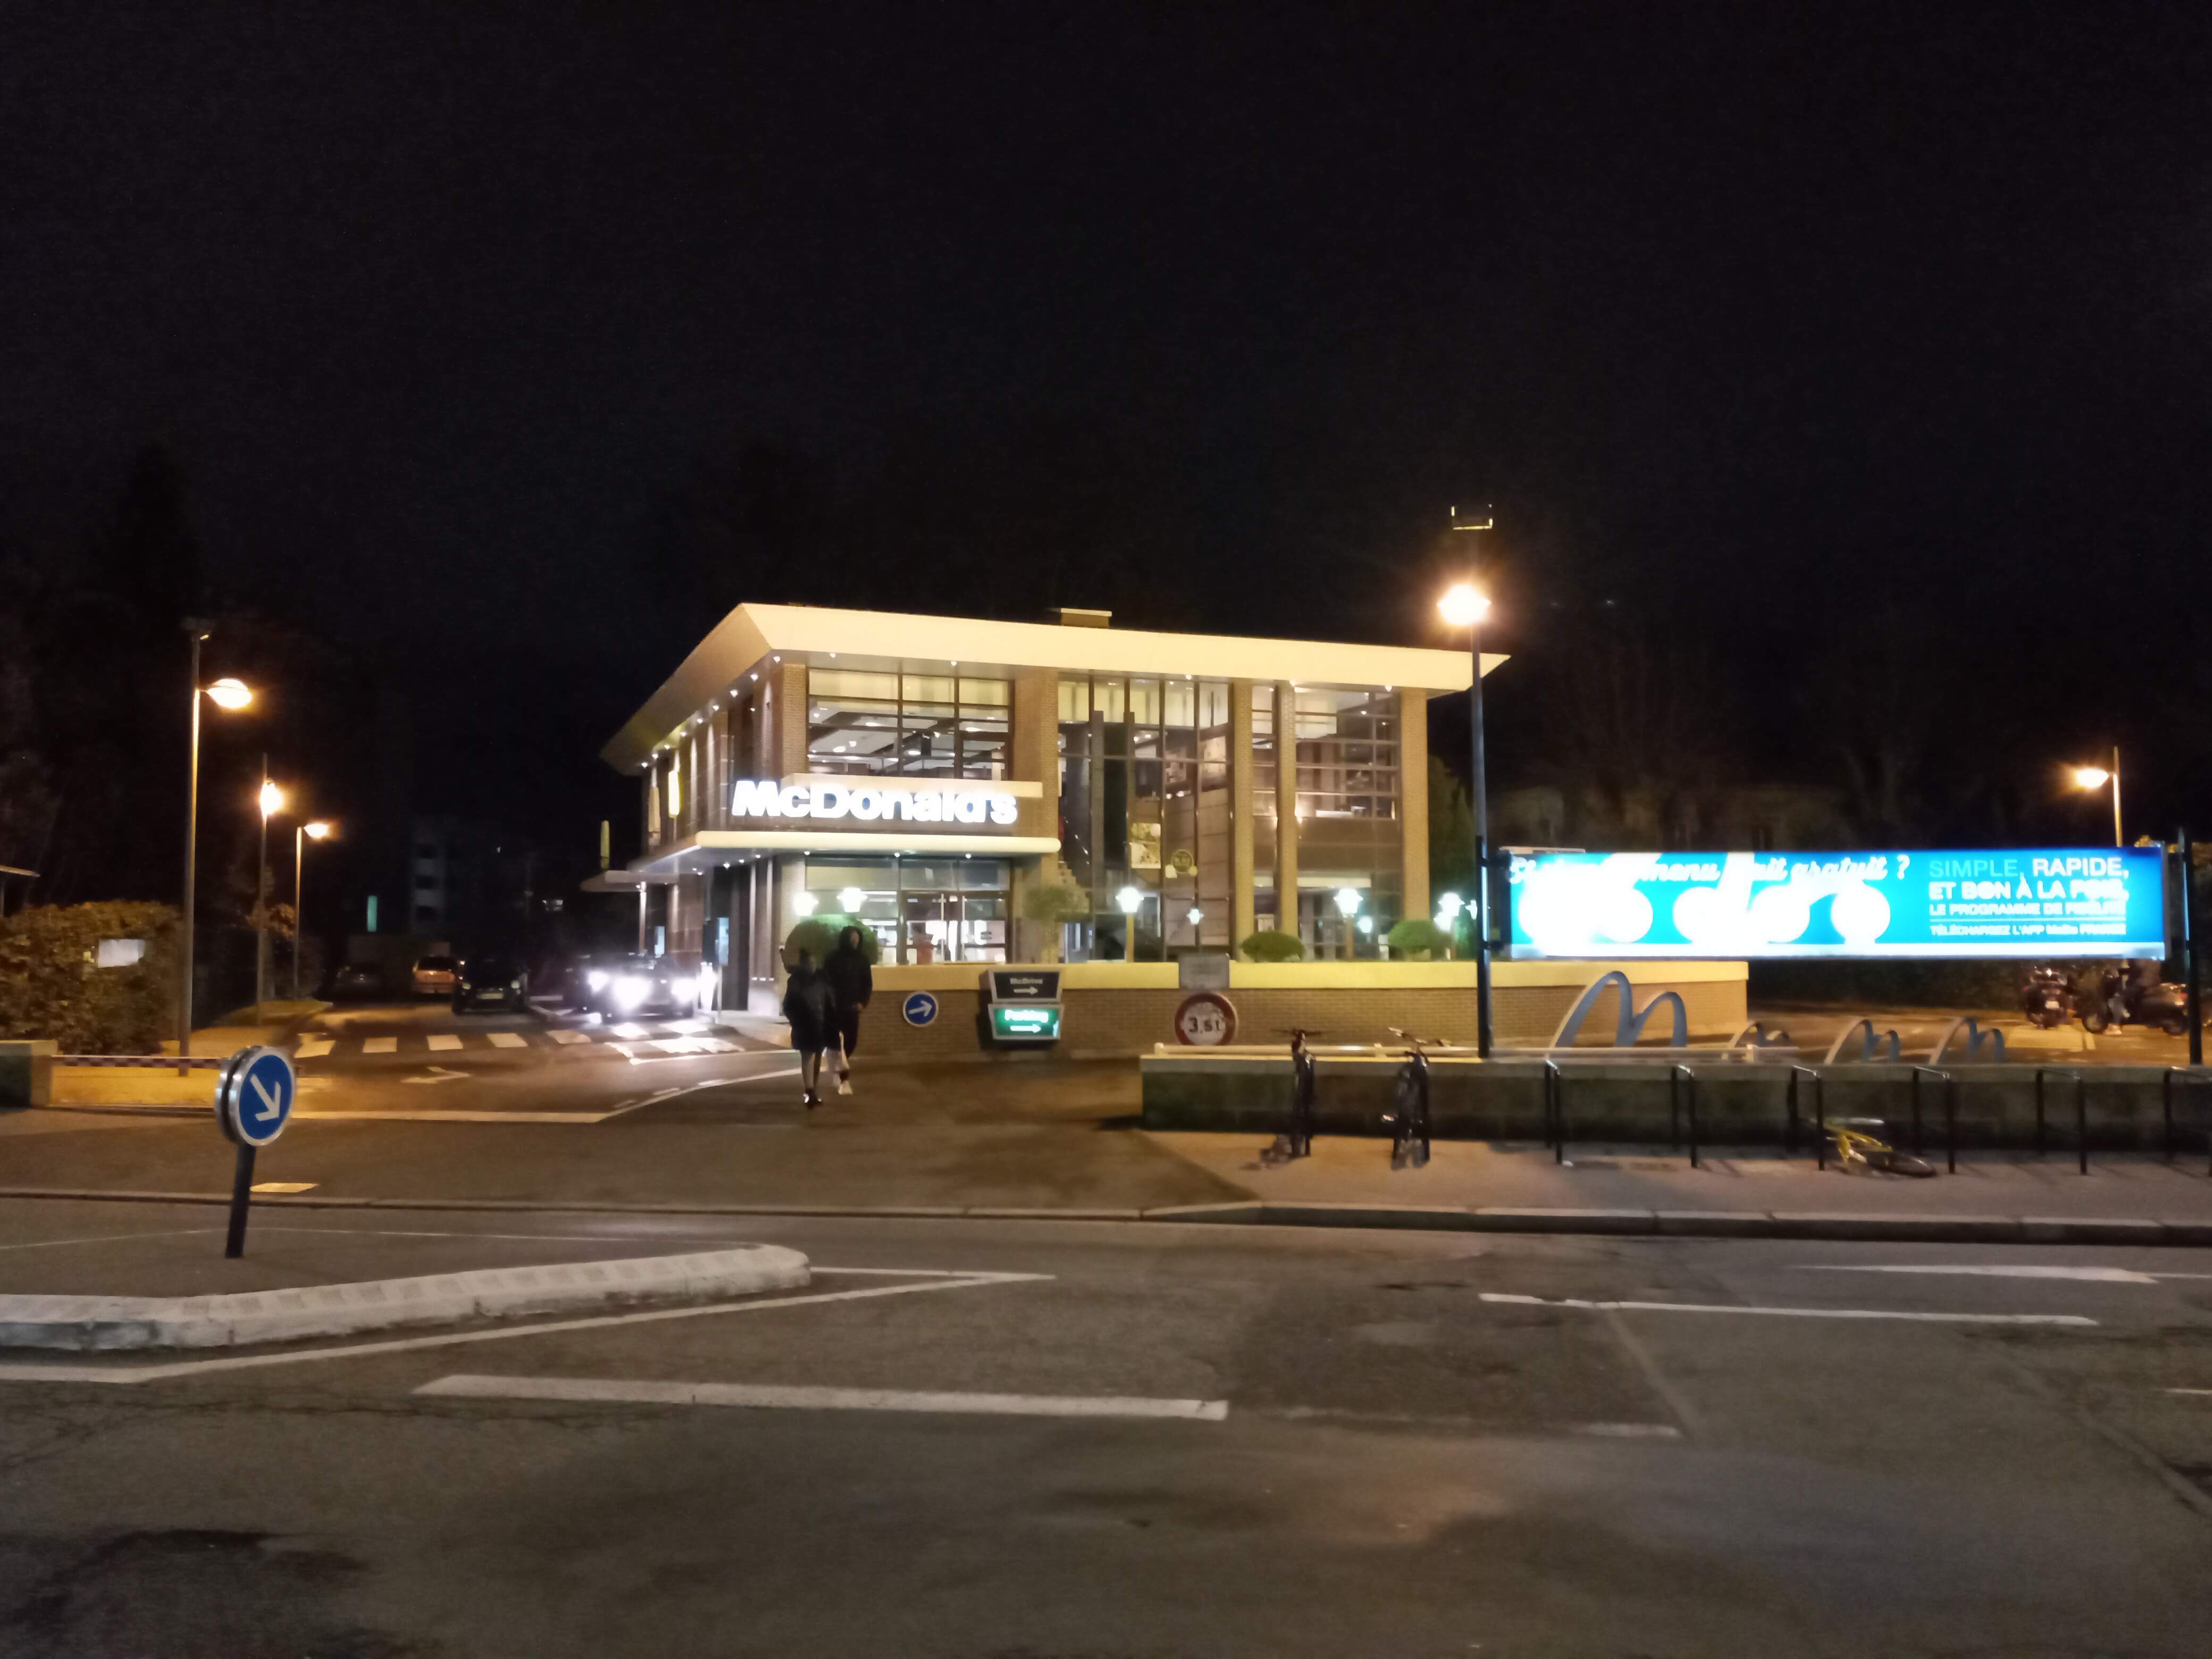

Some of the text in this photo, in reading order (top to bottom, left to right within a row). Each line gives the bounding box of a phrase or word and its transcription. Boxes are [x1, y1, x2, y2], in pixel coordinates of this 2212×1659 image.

[732, 780, 1018, 825] McDonald's
[2033, 857, 2130, 879] RAPIDE,
[1929, 882, 1957, 900] ET
[1962, 881, 2012, 900] BON
[2037, 880, 2066, 899] LA
[1930, 903, 1946, 915] LE
[1950, 903, 2040, 915] PROGRAMME
